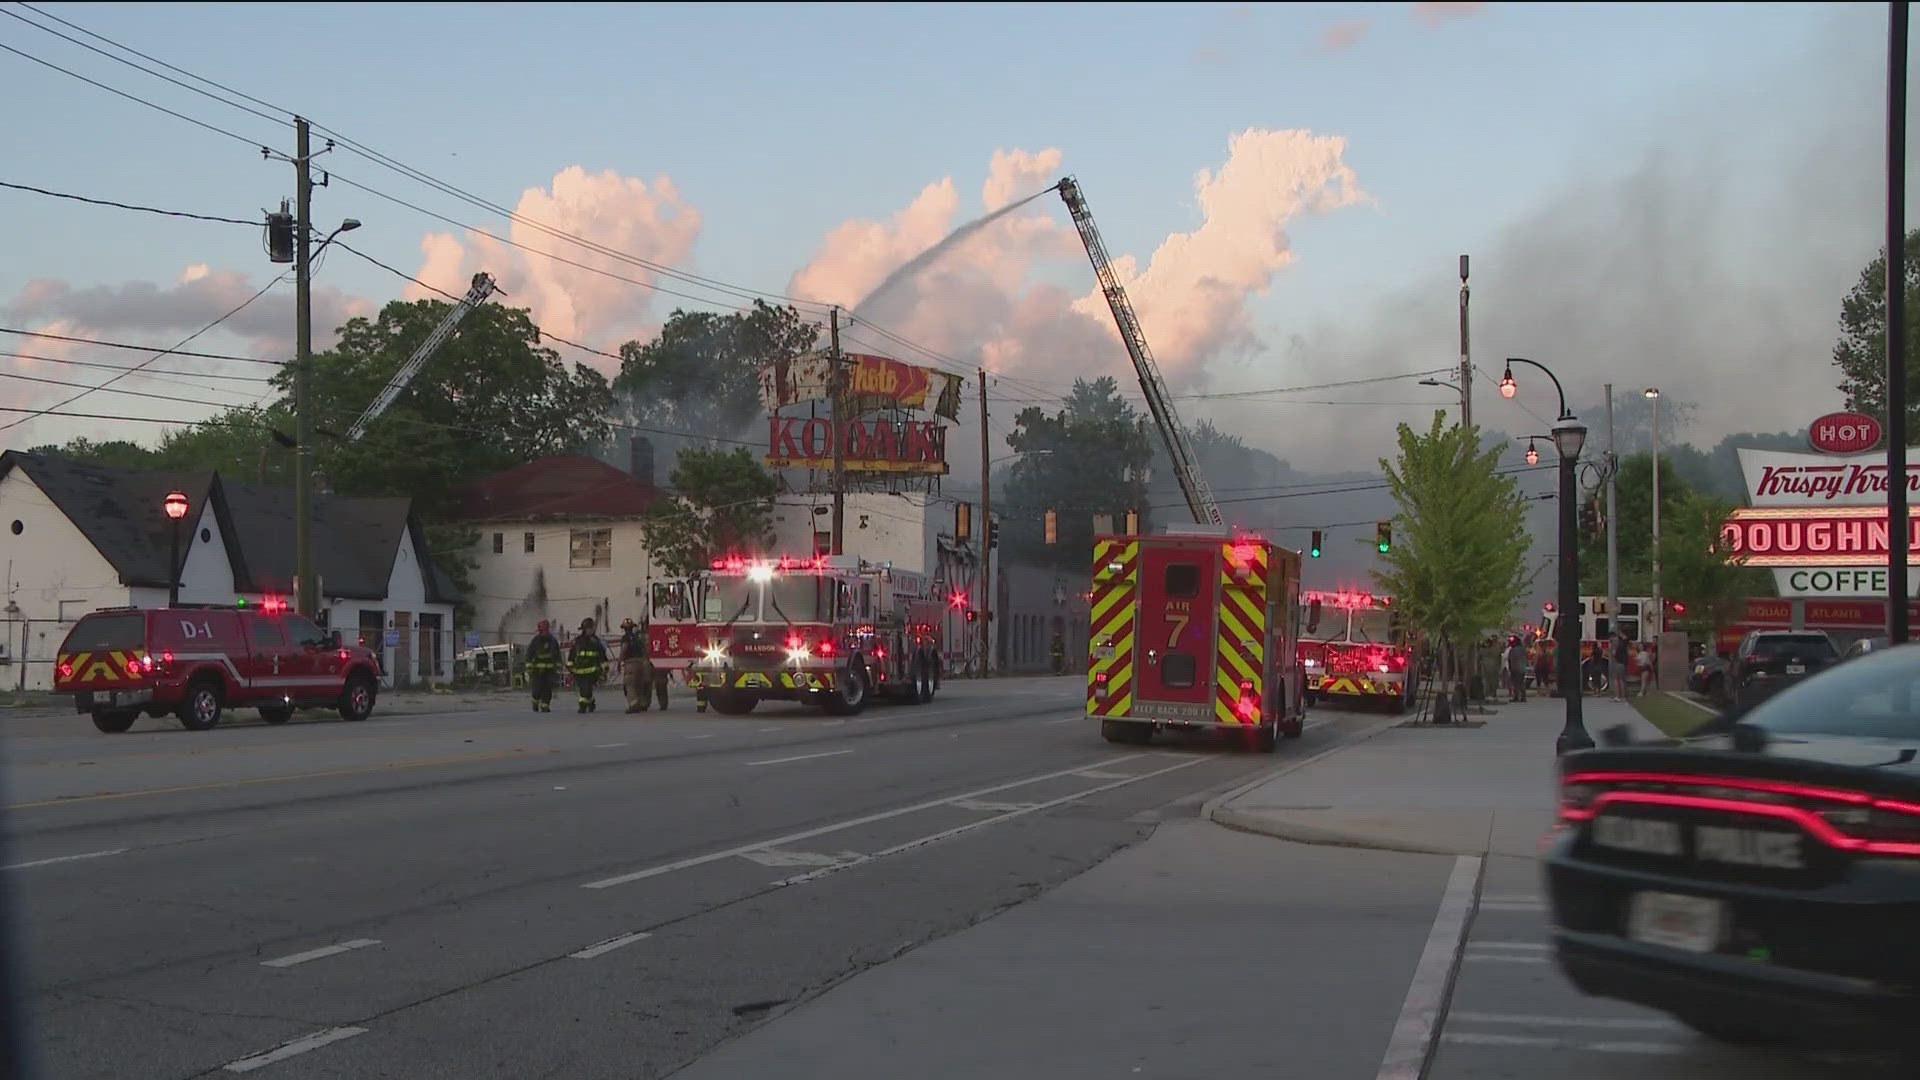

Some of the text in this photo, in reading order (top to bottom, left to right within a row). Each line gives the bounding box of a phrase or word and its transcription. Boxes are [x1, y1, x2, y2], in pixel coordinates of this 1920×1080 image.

[854, 355, 898, 393] hoto
[765, 416, 939, 463] KODAK
[1820, 425, 1871, 442] HOT
[1757, 464, 1847, 499] Krispy
[1790, 571, 1886, 591] COFFE
[1165, 601, 1190, 612] AIR
[1811, 609, 1861, 619] ATLANTA
[180, 620, 213, 638] D-1
[1165, 614, 1190, 648] 7
[272, 653, 279, 674] 1
[1134, 705, 1211, 717] KEEP BACK 200 FT
